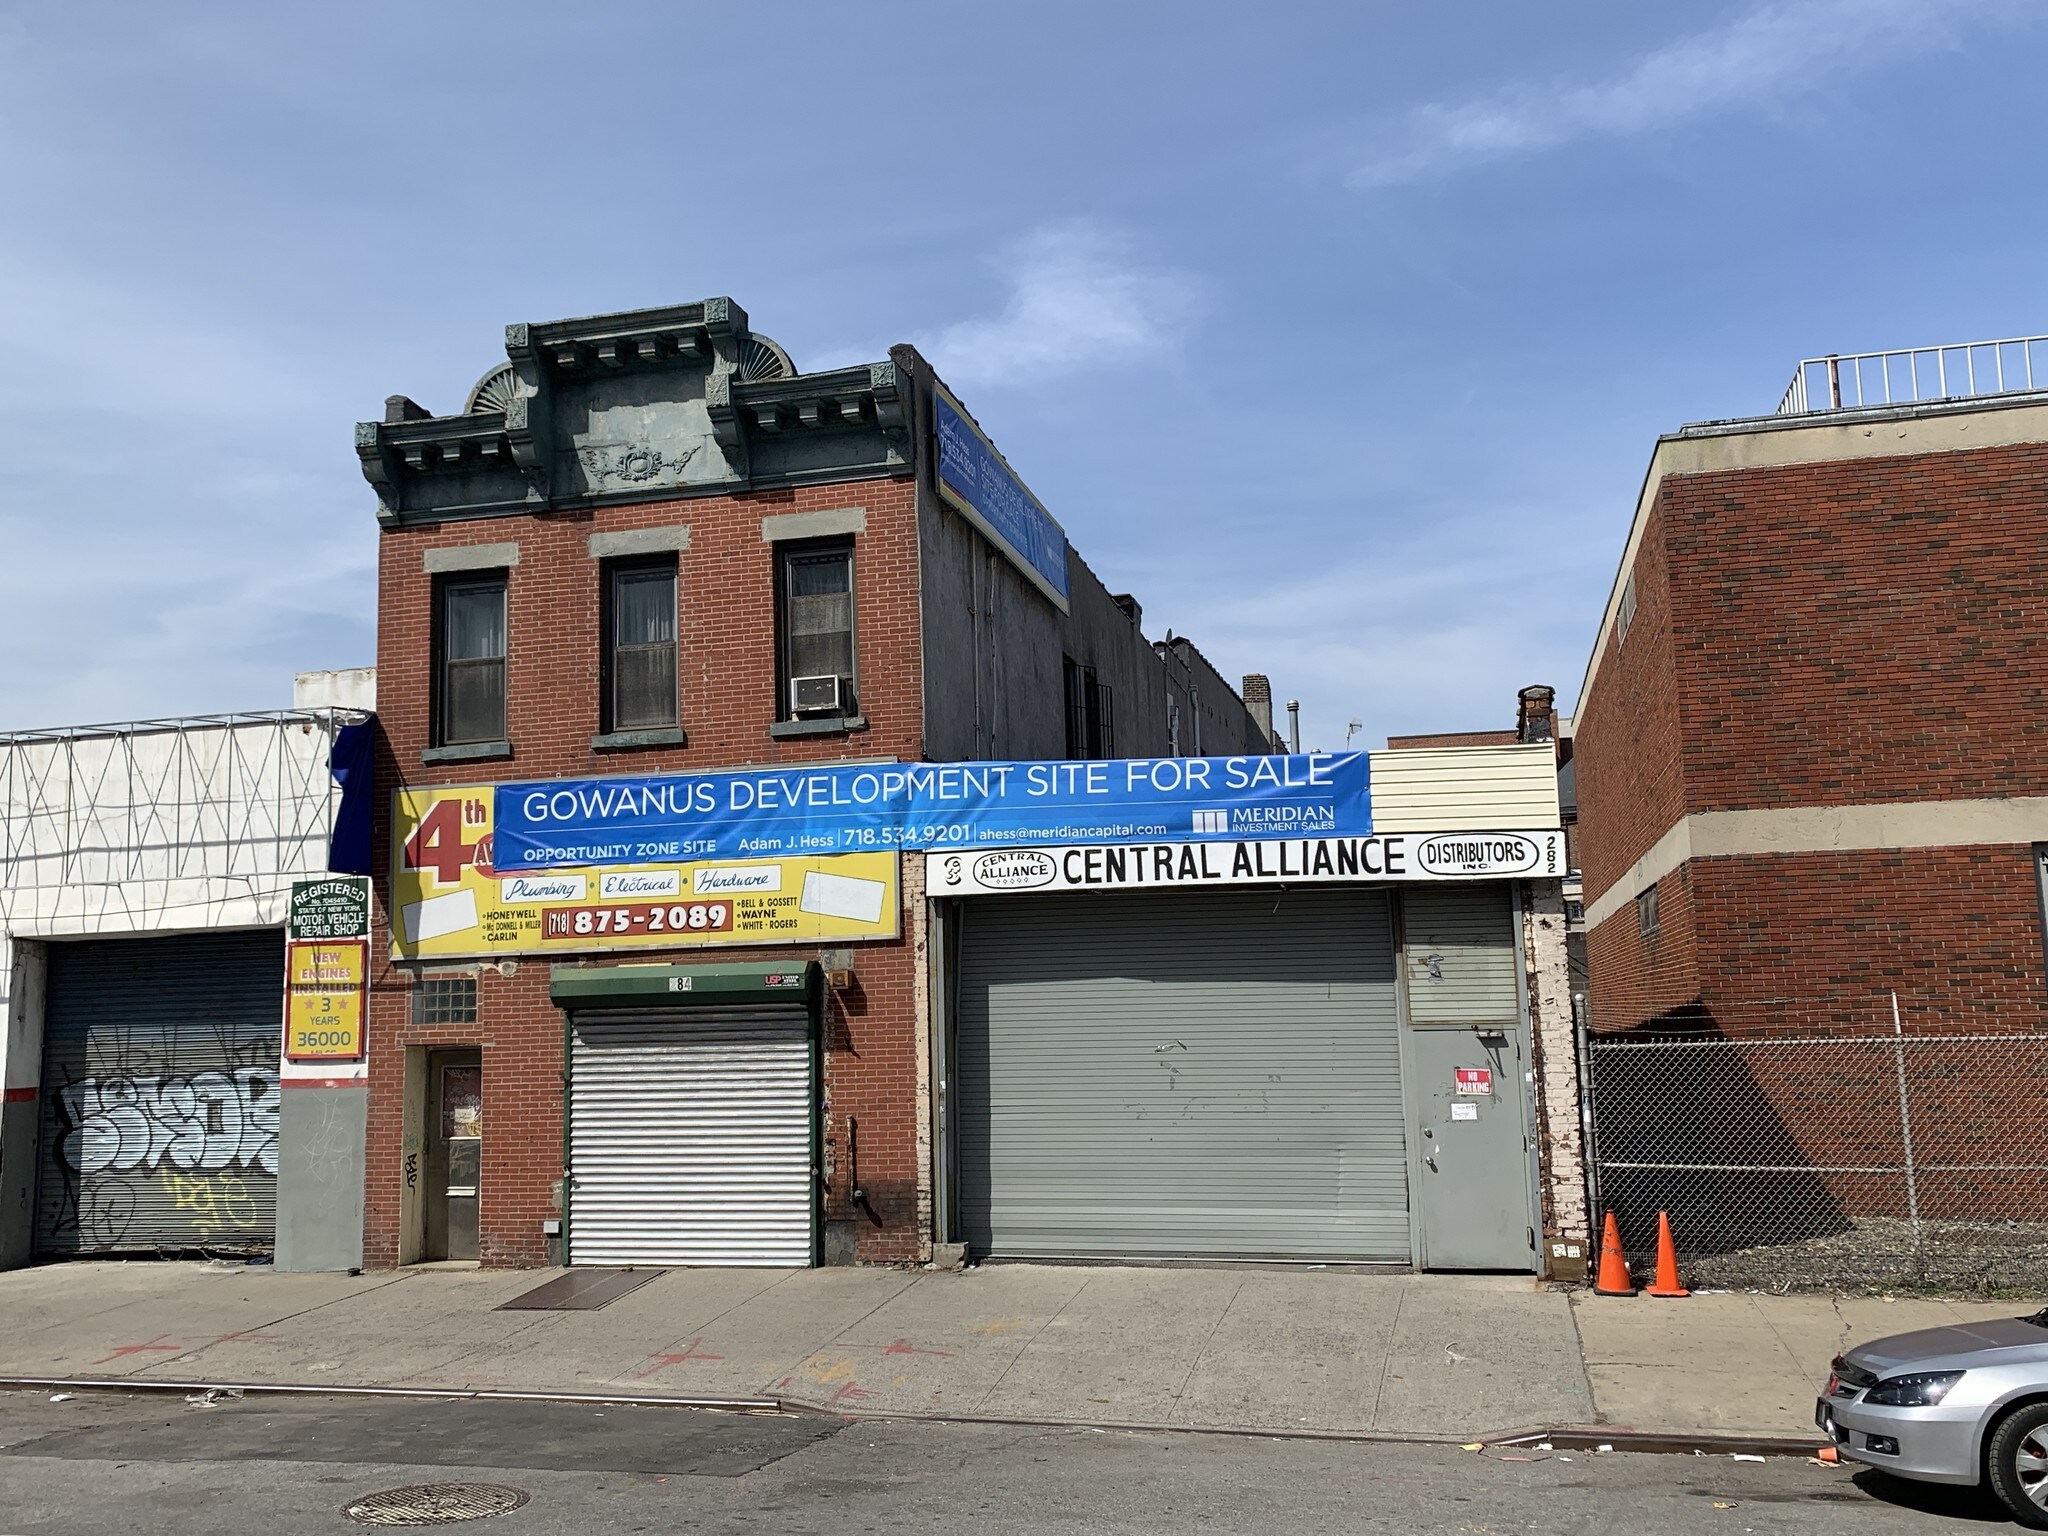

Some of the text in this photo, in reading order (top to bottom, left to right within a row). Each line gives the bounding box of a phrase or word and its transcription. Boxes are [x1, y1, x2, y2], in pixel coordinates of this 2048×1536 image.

[523, 755, 1333, 821] GOWANUS DEVELOPMENT SITE FOR SALE
[1233, 806, 1334, 822] MERIDIAN
[979, 822, 1167, 841] ahess@meridiancapital.com
[1233, 821, 1336, 832] INVESTMENT SALES
[738, 834, 834, 850] Adam J. Hess
[844, 824, 969, 846] 718.534.9201
[524, 839, 716, 862] OPPORTUNITY ZONE SITE
[1427, 842, 1525, 864] DISTRIBUTORS
[982, 853, 1045, 867] CENTRAL
[1063, 837, 1406, 884] CENTRAL ALLIANCE
[980, 864, 1049, 879] ALLIANCE
[605, 876, 674, 893] Electrical
[697, 870, 769, 892] Hardware
[293, 883, 366, 907] REGISTERED
[505, 879, 577, 900] Plumbing
[741, 897, 797, 908] BELL & GOSSETT
[293, 912, 365, 926] MOTOR VEHICLE
[487, 910, 536, 921] HONEYWELL
[548, 904, 727, 937] (718) 875-2089
[742, 909, 776, 919] WAYNE
[300, 924, 359, 936] REPAIR SHOP
[496, 921, 518, 931] DONNELL
[519, 921, 524, 929] &
[525, 920, 541, 929] MILLER
[742, 919, 798, 930] WHITE ROGERS
[487, 932, 517, 942] CARLIN
[311, 952, 341, 965] NEW
[301, 968, 351, 980] ENGINES
[765, 976, 782, 985] USP
[294, 983, 357, 996] INSTALLED
[321, 998, 331, 1012] 3
[310, 1016, 340, 1025] YEARS
[298, 1031, 351, 1047] 36000
[1468, 1072, 1478, 1081] NO
[1458, 1082, 1489, 1092] PARKING
